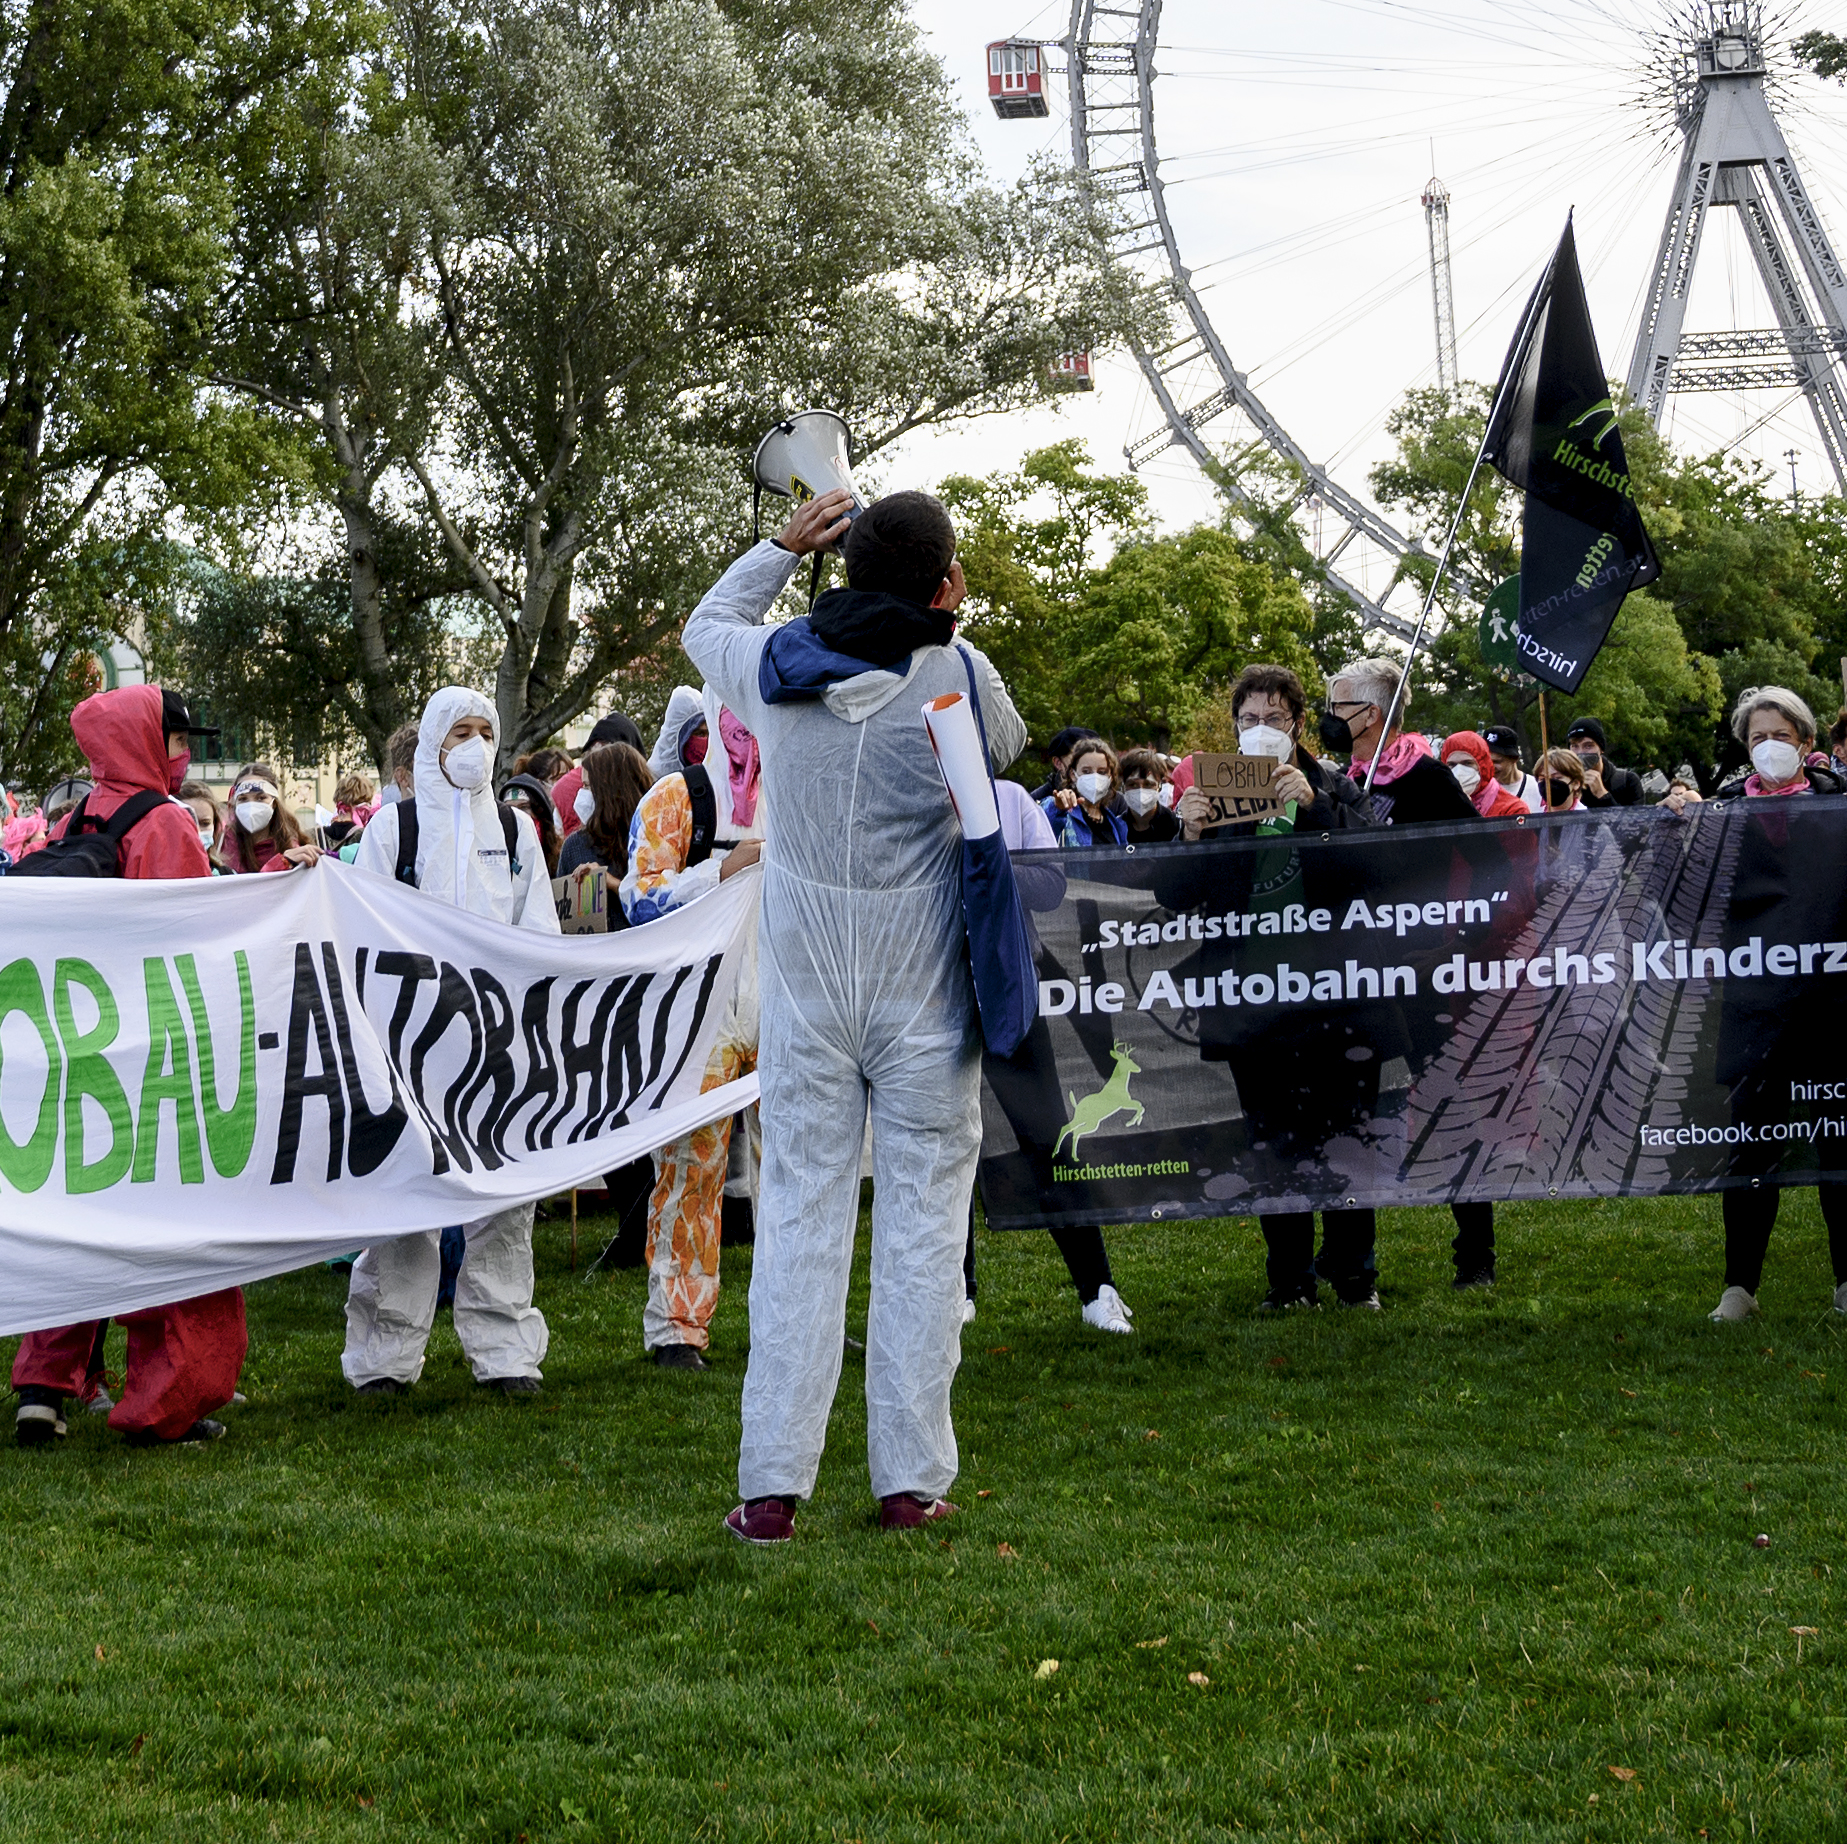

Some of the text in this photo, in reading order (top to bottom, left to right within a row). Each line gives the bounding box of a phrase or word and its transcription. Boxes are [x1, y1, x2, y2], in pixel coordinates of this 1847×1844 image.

[1198, 760, 1271, 788] LOBAU
[1038, 974, 1124, 1016] Die
[1137, 960, 1417, 1011] Autobahn
[1432, 947, 1615, 991] durchs
[1052, 1157, 1190, 1183] Hirschstetten-retten
